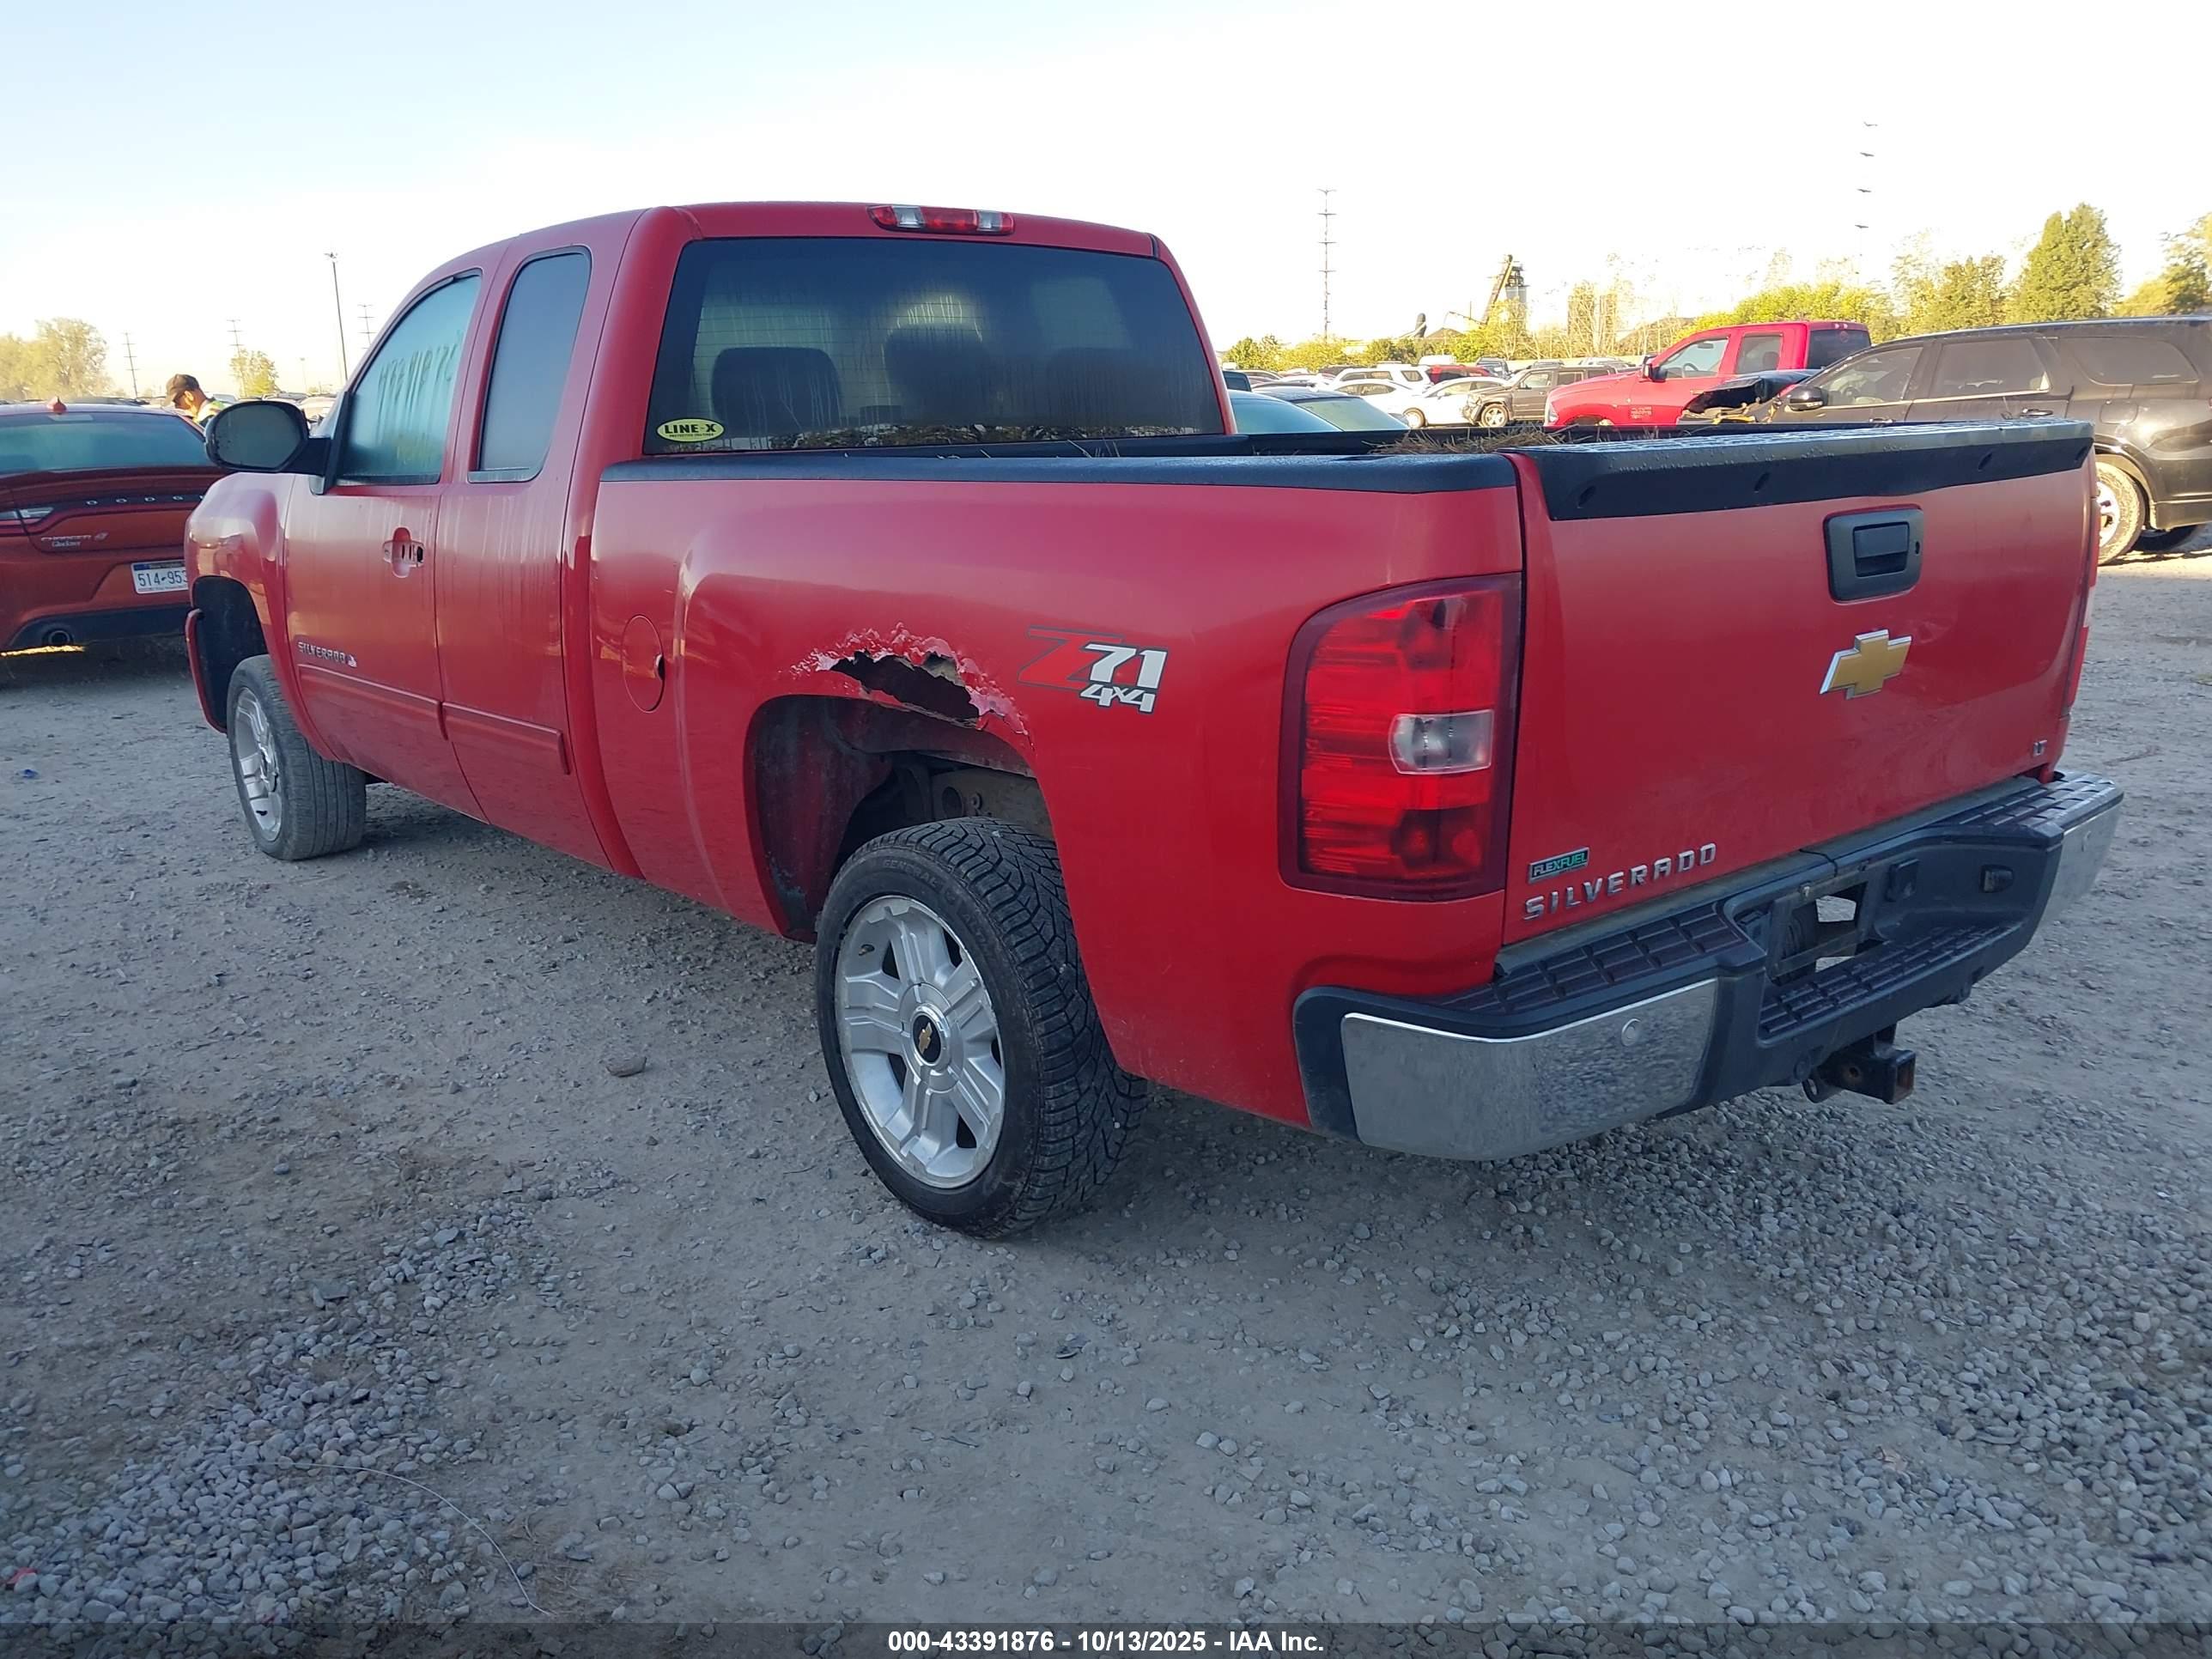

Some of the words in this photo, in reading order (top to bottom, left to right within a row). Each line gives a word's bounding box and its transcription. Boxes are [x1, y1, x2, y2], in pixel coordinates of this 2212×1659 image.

[665, 423, 717, 434] LINE-X
[86, 495, 204, 505] DODG
[297, 641, 346, 665] SILVERADO
[1018, 627, 1169, 690] Z71
[1534, 852, 1588, 876] FLEXFUEL
[1524, 842, 1717, 920] SILVERADO
